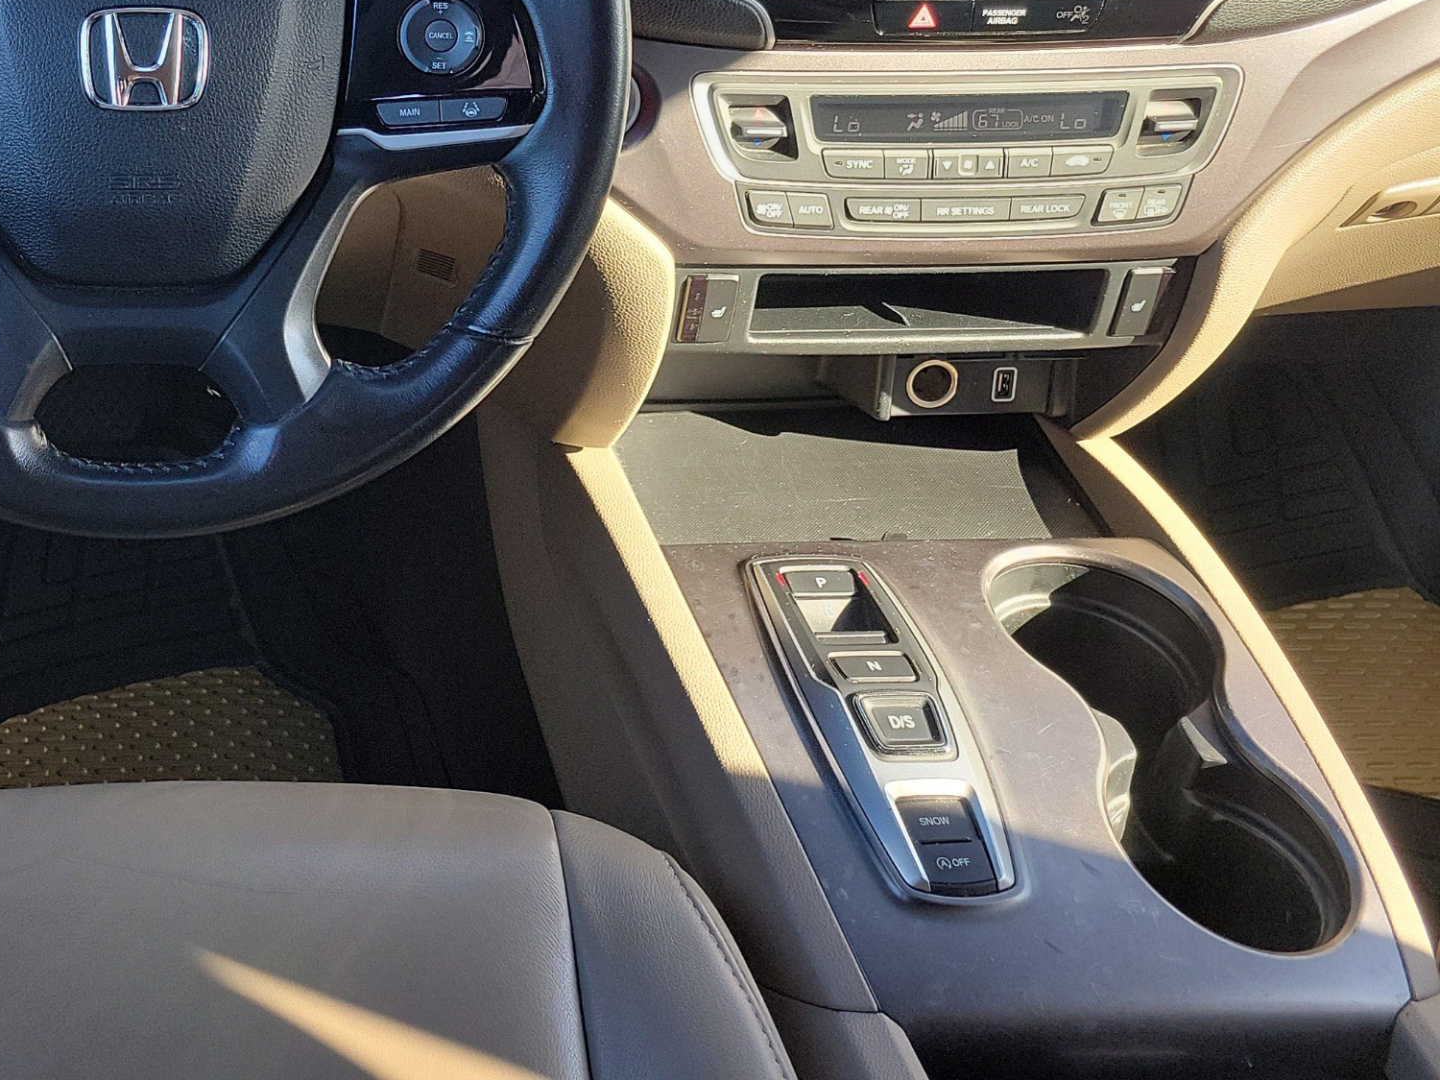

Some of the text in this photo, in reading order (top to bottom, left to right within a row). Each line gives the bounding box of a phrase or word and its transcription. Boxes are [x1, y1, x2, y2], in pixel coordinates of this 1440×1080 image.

[433, 2, 449, 10] RES
[982, 9, 1027, 17] PASSENGER
[1056, 11, 1074, 19] OFF
[986, 17, 1019, 25] AIRBAG
[432, 61, 447, 69] SET
[399, 107, 421, 117] MAIN
[1023, 115, 1054, 123] A/C ON
[845, 159, 874, 170] SYNC
[1020, 158, 1039, 169] A/C
[1109, 201, 1133, 209] FRONT
[1147, 198, 1166, 206] REAR
[798, 205, 824, 214] AUTO
[858, 206, 884, 215] REAR
[950, 206, 995, 216] SETTINGS
[1020, 203, 1070, 214] REAR LOCK
[815, 577, 827, 589] P
[867, 661, 882, 671] N
[888, 715, 915, 729] D/S
[918, 816, 950, 826] SNOW
[951, 857, 971, 867] OFF
